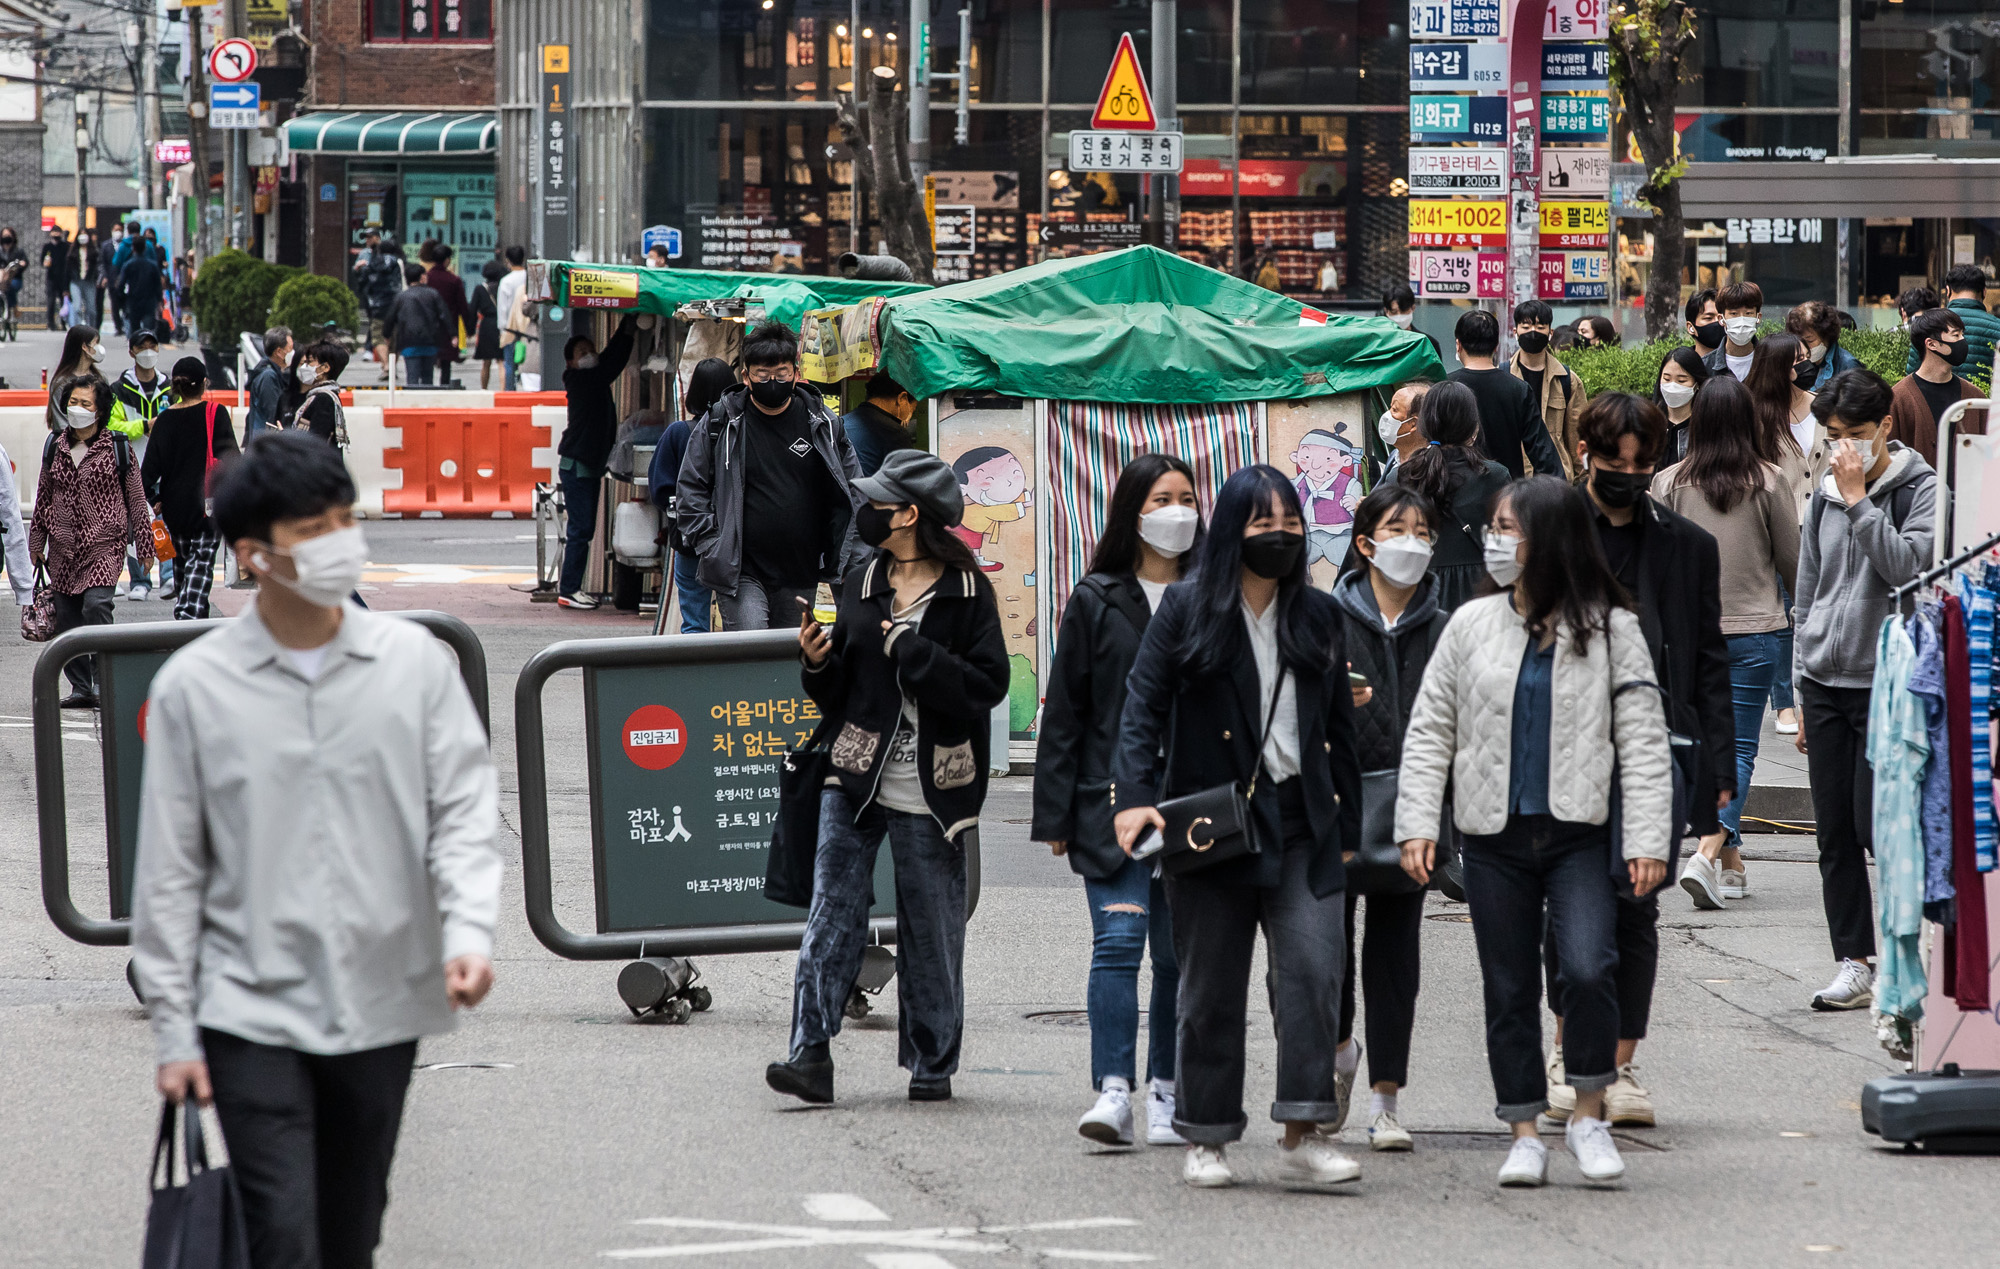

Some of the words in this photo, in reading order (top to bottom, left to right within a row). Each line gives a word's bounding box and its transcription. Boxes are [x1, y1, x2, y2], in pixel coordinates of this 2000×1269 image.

[1411, 6, 1446, 33] 안과
[1453, 9, 1470, 20] 렌즈
[1452, 22, 1499, 34] 322-8275
[1413, 50, 1462, 76] 박수갑
[1474, 70, 1502, 82] 605호
[1546, 99, 1587, 114] 각종등기
[1473, 122, 1502, 135] 612호
[1546, 115, 1587, 130] 법무상담
[1415, 207, 1501, 227] 3141-1002
[1541, 208, 1563, 227] 1층
[1443, 257, 1472, 278] 직방
[1480, 260, 1504, 274] 지하
[1540, 260, 1563, 275] 지하
[574, 273, 602, 282] 닭꼬치
[1483, 278, 1504, 292] 1층
[1543, 278, 1562, 292] 1층
[587, 298, 619, 307] 카드환영
[711, 698, 821, 726] 어울마당로
[633, 730, 676, 744] 진입금지
[713, 732, 735, 757] 차
[742, 730, 786, 757] 없는
[713, 765, 739, 777] 걸으면
[741, 763, 779, 775] 바뀝니다.
[715, 788, 754, 801] 운영시간
[627, 807, 665, 828] 걷자,
[715, 812, 760, 828] 금.토.일
[630, 826, 664, 845] 마포
